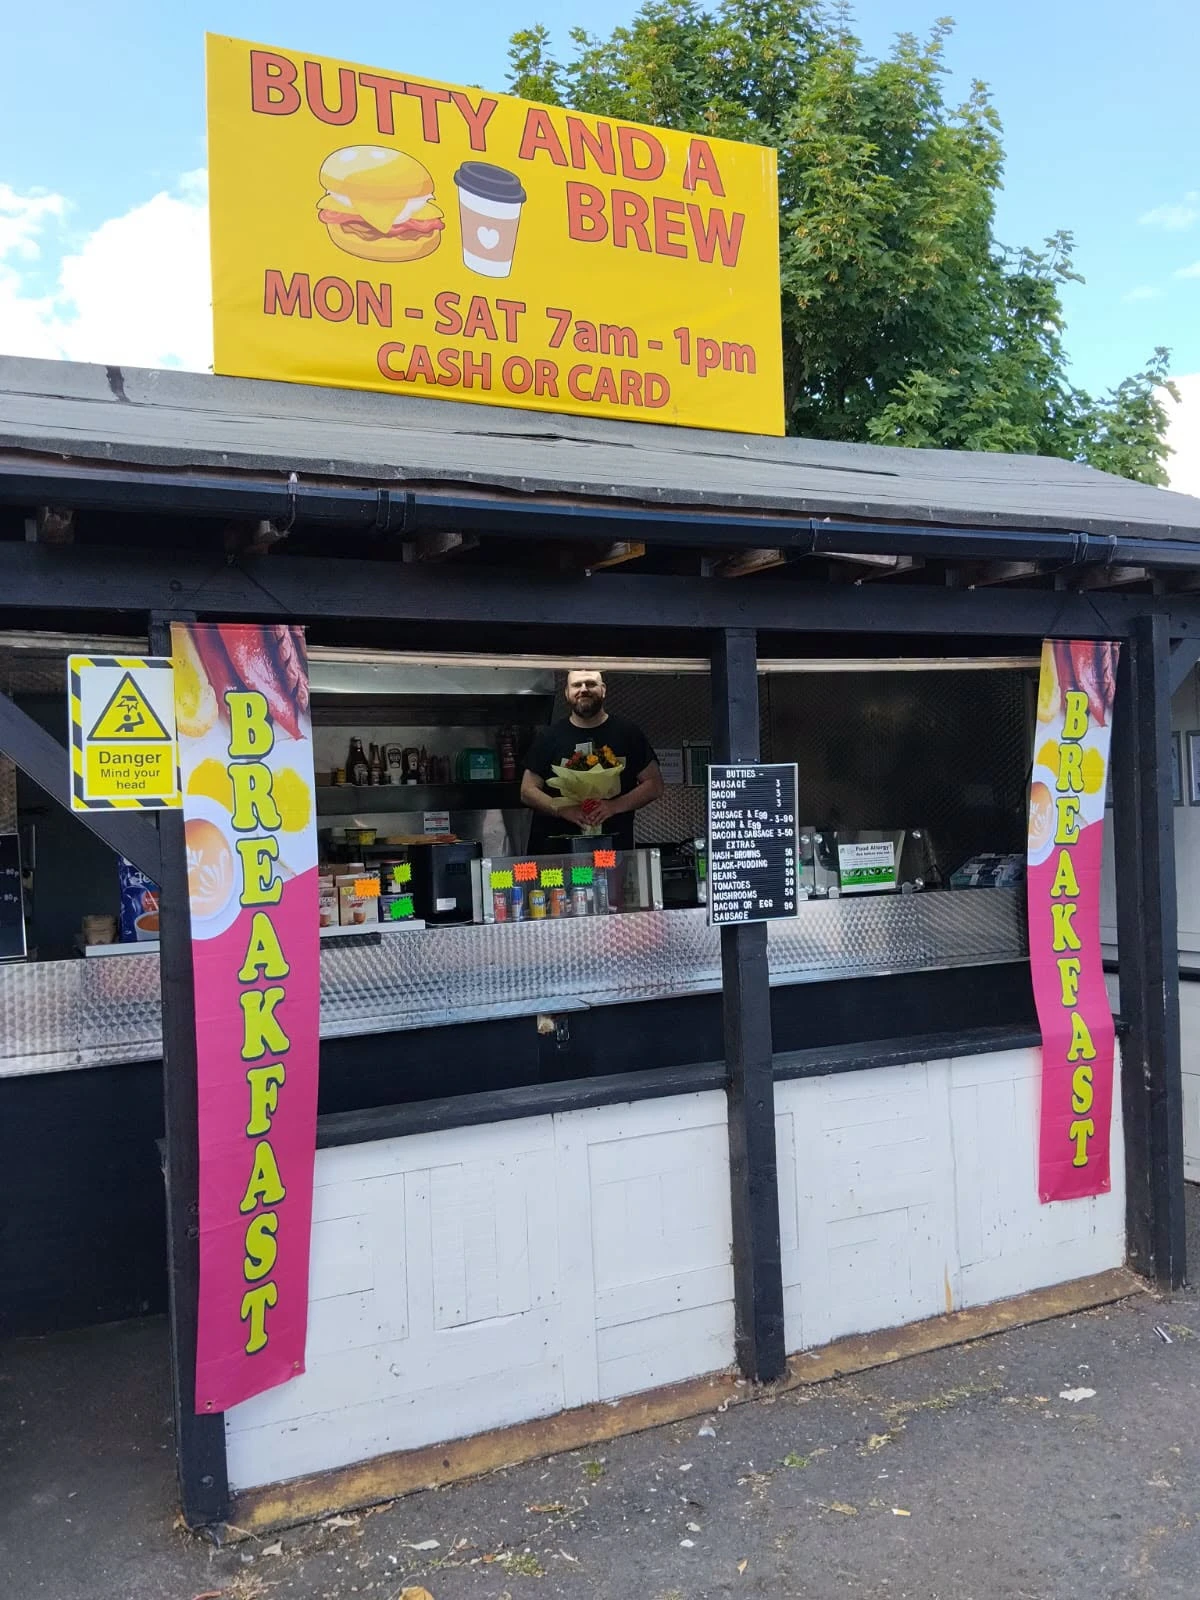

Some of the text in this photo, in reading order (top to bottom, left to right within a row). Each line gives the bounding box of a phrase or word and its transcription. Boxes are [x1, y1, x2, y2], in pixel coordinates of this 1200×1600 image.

[250, 49, 725, 197] BUTTY AND A
[566, 180, 745, 268] BREW
[263, 270, 393, 328] MON
[434, 291, 526, 343] SAT
[546, 307, 638, 357] 7am
[673, 327, 757, 377] 1pm
[377, 342, 670, 409] CASH OR CARD
[98, 751, 162, 768] Danger
[100, 769, 160, 780] Mind your
[726, 769, 756, 778] BUTTIES
[116, 780, 146, 790] head
[711, 779, 781, 789] SAUSAGE 3
[711, 789, 781, 799] BACON 3
[711, 799, 781, 809] EGG 3
[711, 810, 743, 819] SAUSAGE
[747, 810, 752, 818] &
[711, 821, 736, 830] BACON
[739, 820, 745, 829] &
[712, 830, 736, 840] BACON
[744, 829, 774, 839] SAUSAGE
[726, 840, 756, 849] EXTRAS
[712, 848, 793, 860] HASH-BROWNS 50
[712, 858, 794, 870] BLACK-PUDDING 50
[712, 868, 794, 880] BEANS 50
[713, 878, 794, 891] TOMATOES 50
[713, 888, 794, 901] MUSHROOMS 50
[713, 901, 738, 911] BACON
[743, 900, 752, 909] OR
[759, 899, 773, 908] EGG
[713, 911, 749, 921] SAUSAGE
[1051, 690, 1097, 1168] BREAKFAST
[225, 690, 290, 1356] BREAKFAST
